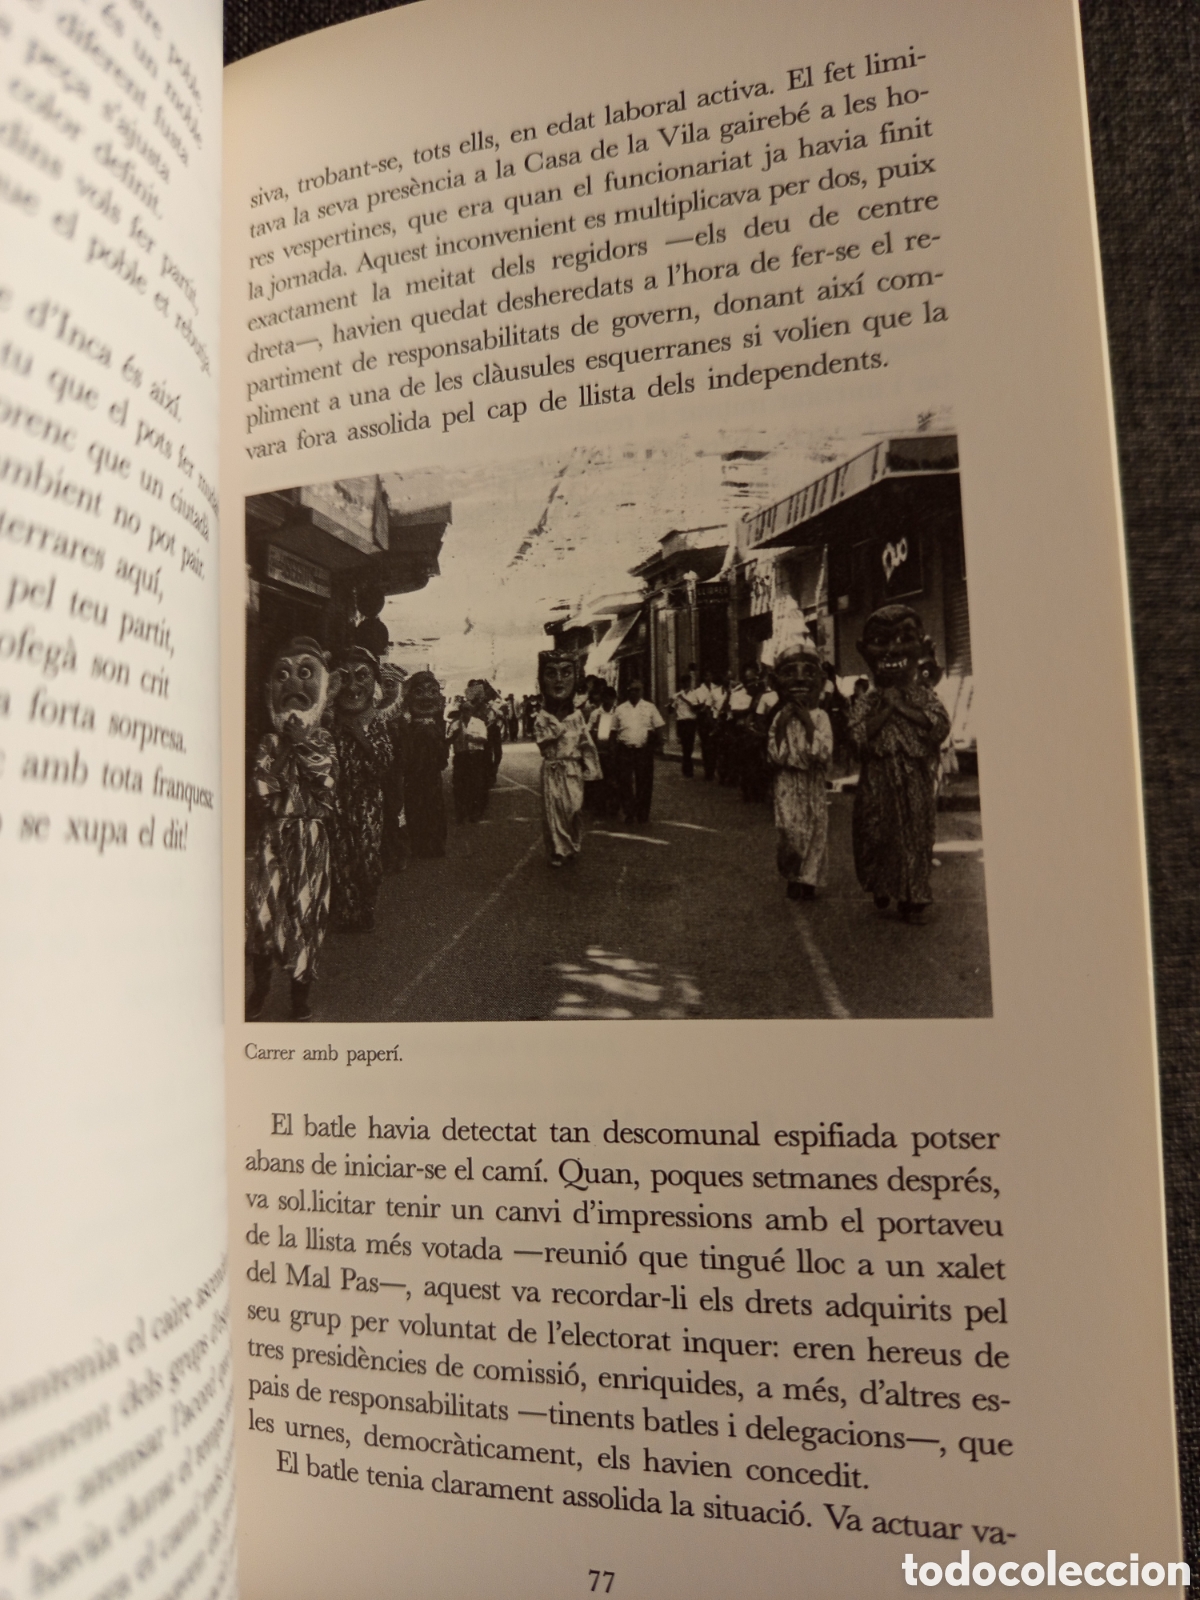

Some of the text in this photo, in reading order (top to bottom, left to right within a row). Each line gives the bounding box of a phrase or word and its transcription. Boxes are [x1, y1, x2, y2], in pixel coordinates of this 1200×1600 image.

[251, 46, 926, 208] siva, trobant-se, tots ells, en edat laboral activa. El fet limi-
[249, 153, 936, 300] la jornada. Aquest inconvenient es multiplicava per dos, puix
[250, 117, 933, 268] res vespertines, que era quan el funcionariat ja havia finit
[248, 291, 356, 331] exactament
[373, 282, 391, 302] la
[406, 267, 475, 295] meitat
[492, 254, 535, 279] dels
[552, 239, 647, 272] regidors
[744, 215, 790, 238] deu
[809, 205, 839, 228] de
[858, 195, 938, 221] centre
[247, 271, 943, 401] partiment de responsabilitats de govern, donant així com-
[246, 352, 888, 459] vara fora assolida pel cap de llista dels independents.
[4, 572, 58, 611] pel
[69, 589, 109, 627] teu
[91, 652, 170, 700] son crit
[27, 686, 188, 755] forta sorpresa.
[20, 749, 144, 796] amb tota
[19, 810, 52, 843] se
[64, 813, 129, 857] xupa
[138, 814, 155, 849] el
[245, 1043, 402, 1066] Carrer amb paperí.
[271, 1113, 1000, 1157] El batle havia detectat tan descomunal espifiada potser
[245, 1149, 1000, 1200] abans de iniciar-se el camí. Quan, poques setmanes després,
[246, 1189, 1004, 1242] va sol.licitar tenir un canvi d'impressions amb el portaveu
[246, 1260, 276, 1284] del
[286, 1263, 331, 1289] Mal
[424, 1281, 501, 1305] aquest
[512, 1286, 541, 1303] va
[552, 1283, 688, 1310] recordar-li
[699, 1286, 733, 1312] els
[745, 1289, 812, 1316] drets
[825, 1292, 952, 1327] adquirits
[964, 1297, 1008, 1331] pel
[248, 1339, 1010, 1412] tres presidències de comissió, enriquides, a més, d'altres es-
[249, 1374, 289, 1400] pais
[296, 1378, 321, 1402] de
[329, 1389, 508, 1421] responsabilitats
[642, 1407, 719, 1436] batles
[728, 1413, 737, 1437] i
[958, 1436, 1013, 1462] que
[249, 1408, 869, 1489] les urnes, democràticament, els havien concedit.
[277, 1449, 1017, 1545] El batle tenia clarament assolida la situació. Va actuar va-
[589, 1569, 615, 1593] 77
